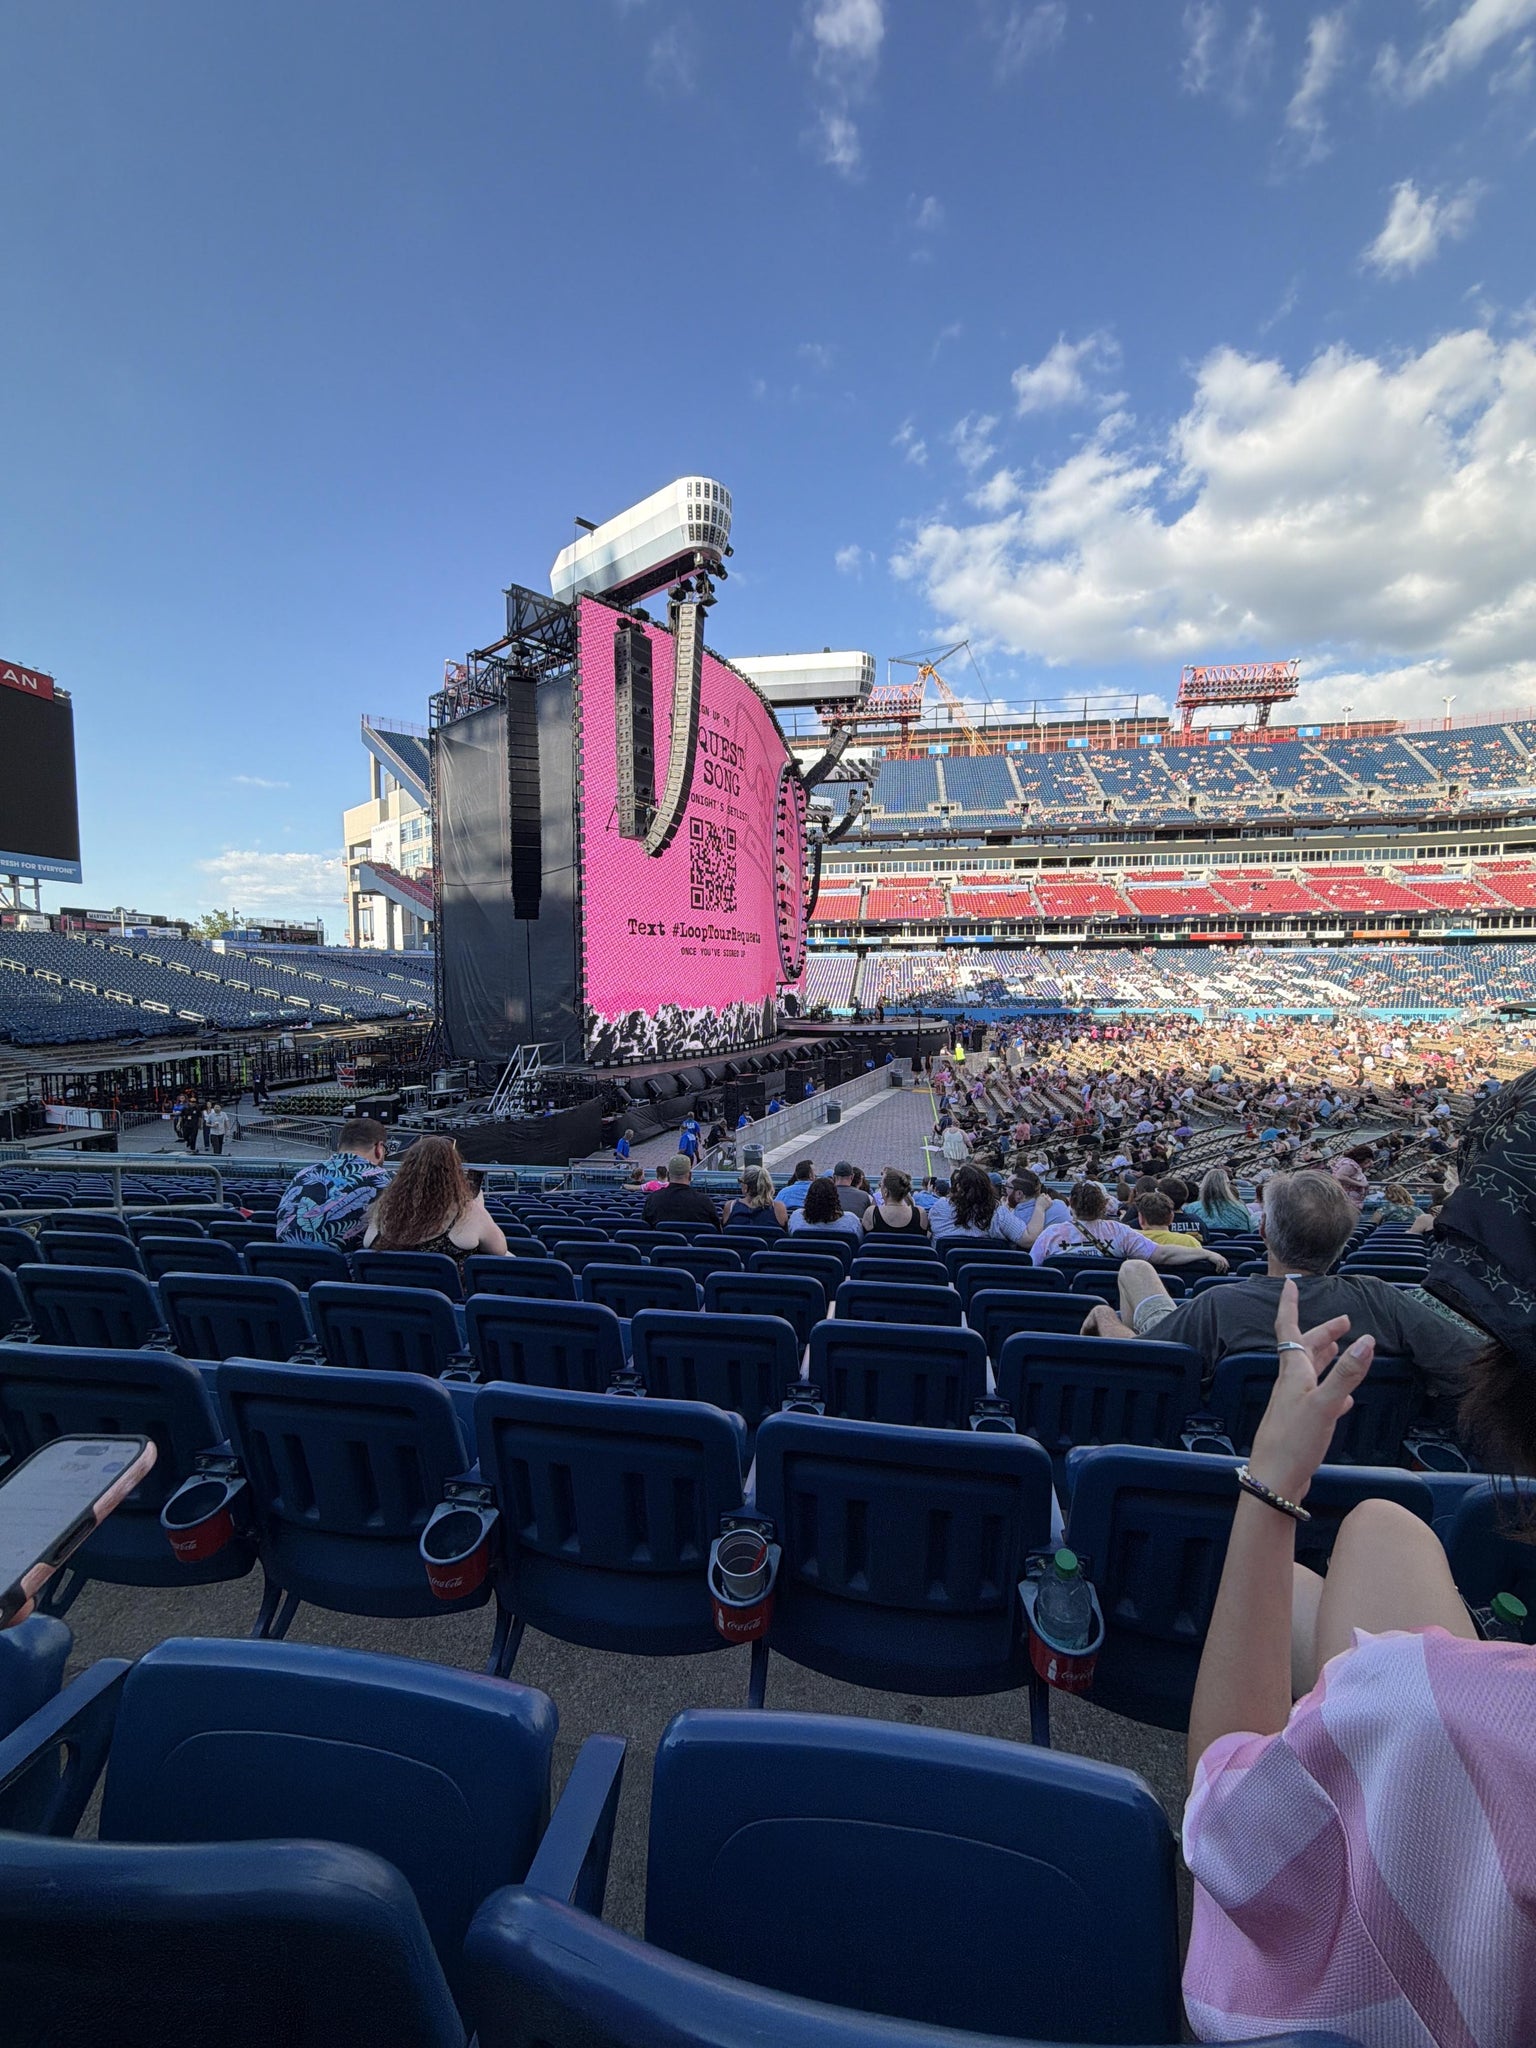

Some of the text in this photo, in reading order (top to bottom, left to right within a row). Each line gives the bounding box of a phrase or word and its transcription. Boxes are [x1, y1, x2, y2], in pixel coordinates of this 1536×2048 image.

[3, 669, 38, 690] AN
[712, 710, 720, 720] UP
[704, 759, 740, 797] SONG
[21, 861, 37, 870] FOR
[628, 918, 760, 945] Text #LoopTourRequests
[681, 947, 697, 956] ONCE
[700, 948, 721, 957] YOU'VE
